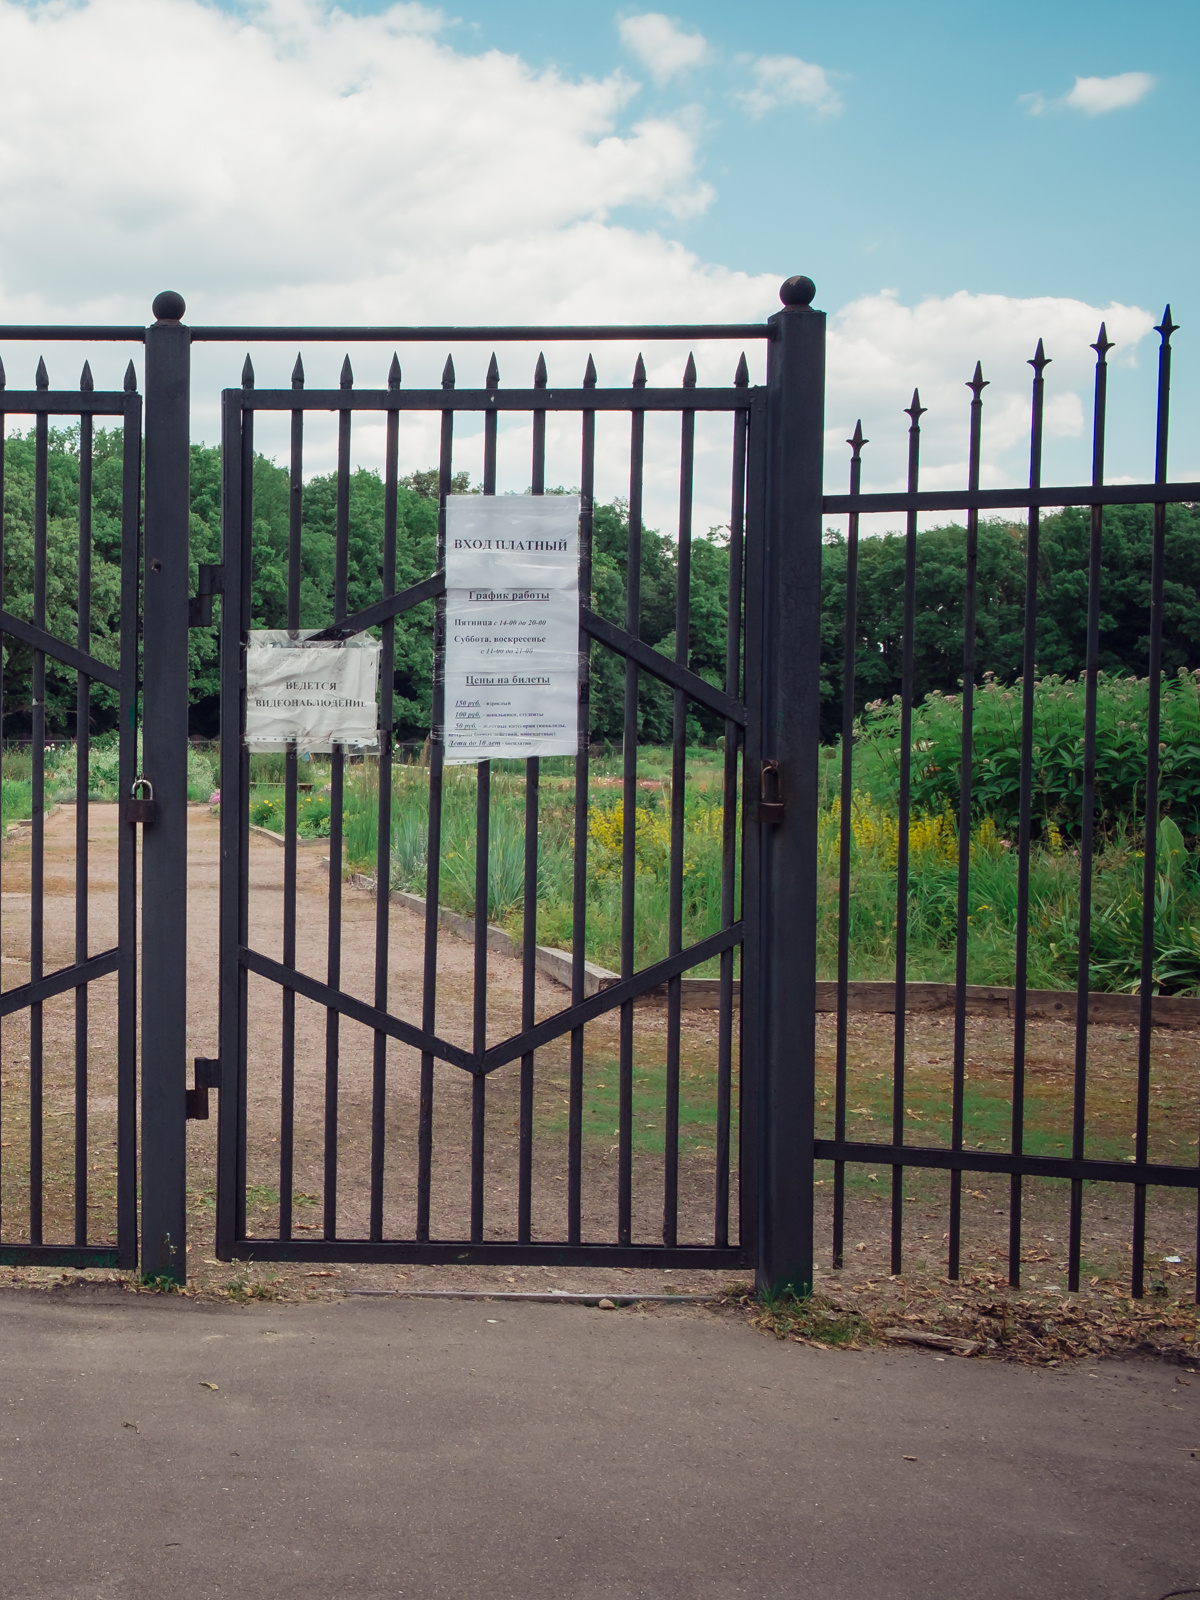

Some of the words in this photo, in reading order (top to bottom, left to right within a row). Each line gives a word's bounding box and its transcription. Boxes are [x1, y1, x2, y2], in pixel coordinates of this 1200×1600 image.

[454, 539, 492, 551] ВХОД
[496, 538, 567, 551] ПЛАТНЫЙ
[469, 591, 509, 601] График
[512, 592, 550, 601] работы
[454, 636, 491, 644] Суббота,
[494, 636, 546, 644] воскресенье
[466, 676, 494, 686] Цены
[512, 675, 550, 684] билеты
[286, 682, 337, 690] ВЕДЕТСЯ
[256, 698, 367, 708] ВИДЕОНАБЛЮДЕНИЕ
